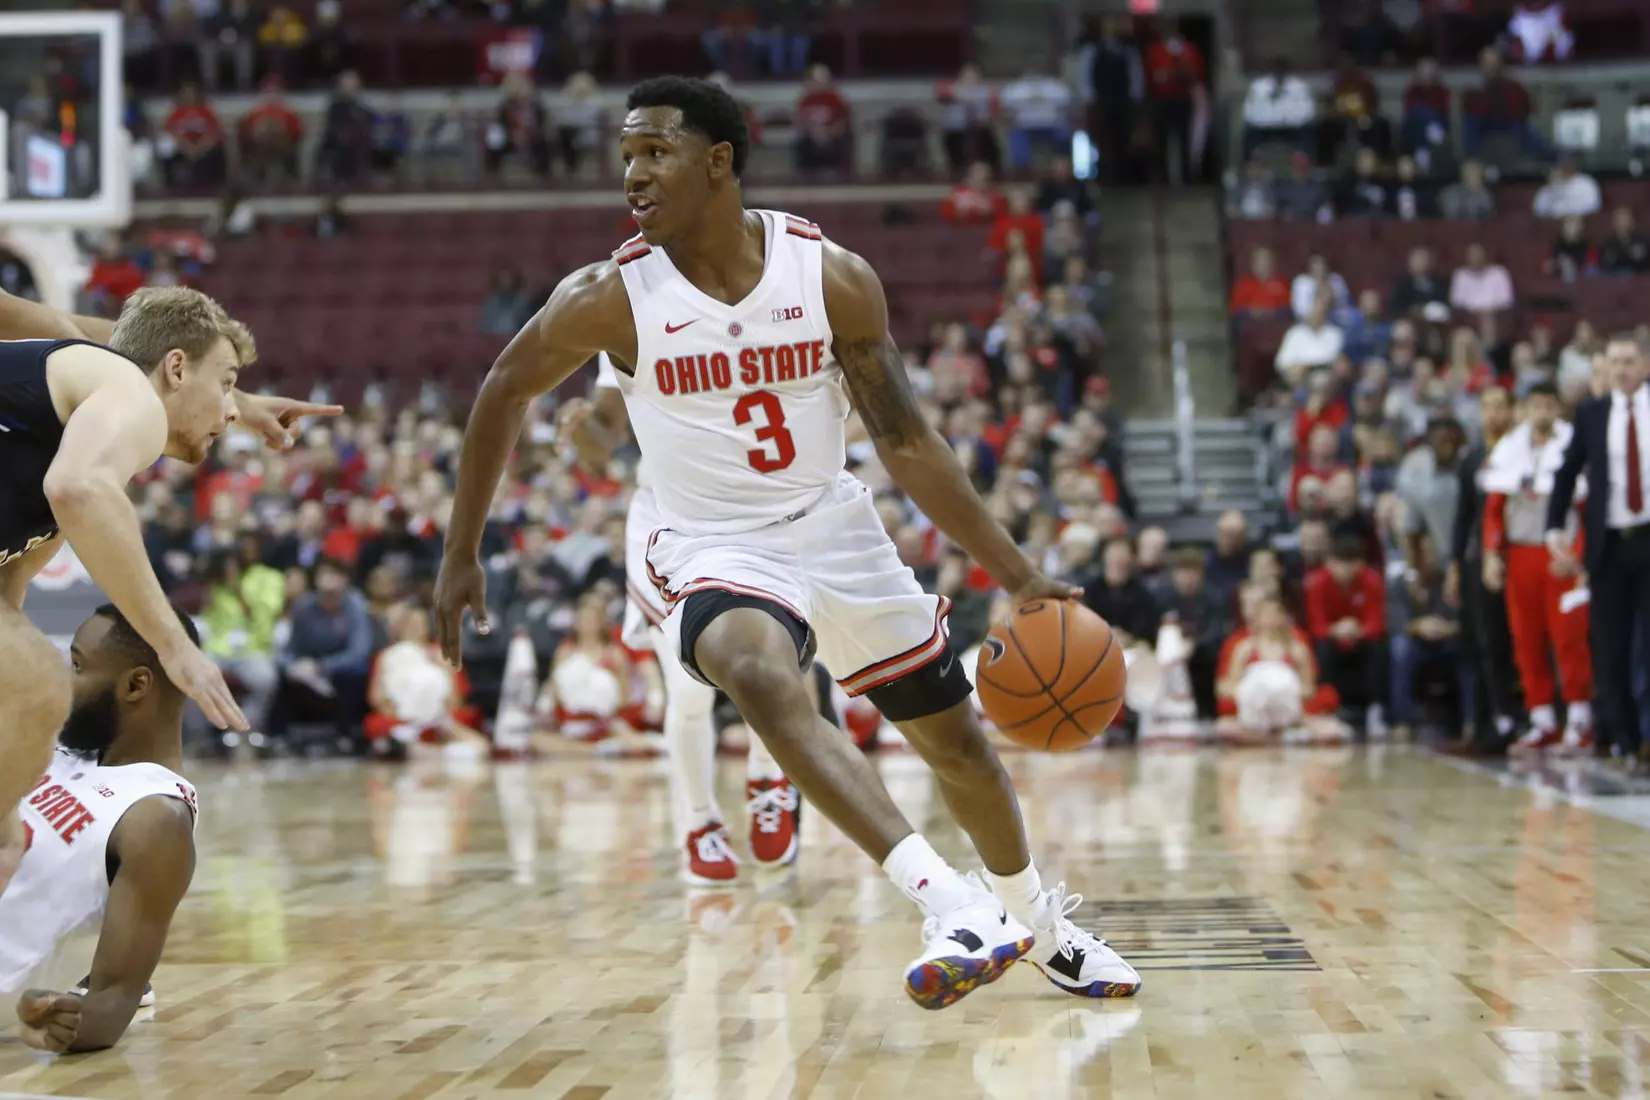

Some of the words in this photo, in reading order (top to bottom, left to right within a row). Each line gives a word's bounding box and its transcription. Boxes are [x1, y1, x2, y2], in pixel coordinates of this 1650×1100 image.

[654, 351, 732, 396] OHIO
[738, 339, 825, 386] STATE
[732, 389, 796, 474] 3
[29, 784, 95, 847] STATE
